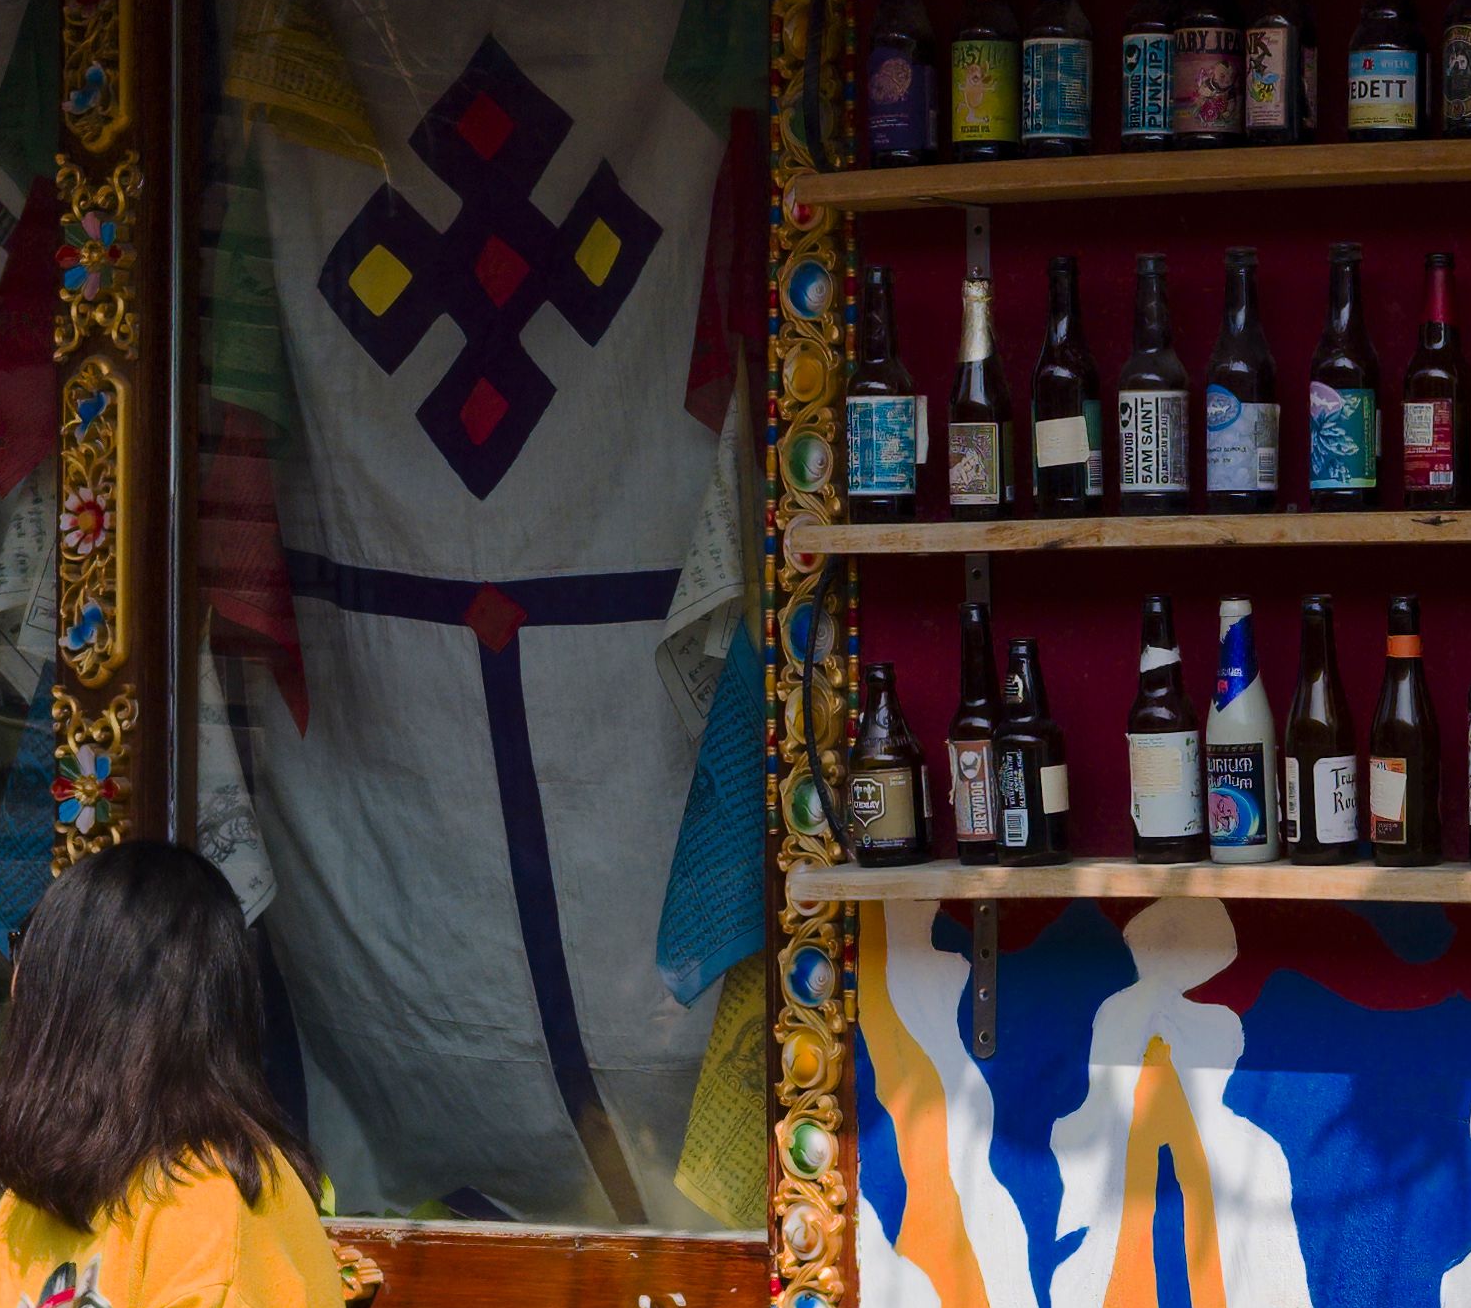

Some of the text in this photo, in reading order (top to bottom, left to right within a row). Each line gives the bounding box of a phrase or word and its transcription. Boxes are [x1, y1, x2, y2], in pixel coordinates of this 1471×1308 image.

[1129, 75, 1142, 127] BREWDOG
[1148, 39, 1164, 128] PUNK IPA
[1123, 432, 1134, 484] BREWDOG
[1141, 397, 1153, 484] 5AM SAINT
[971, 781, 988, 835] BREWDOG
